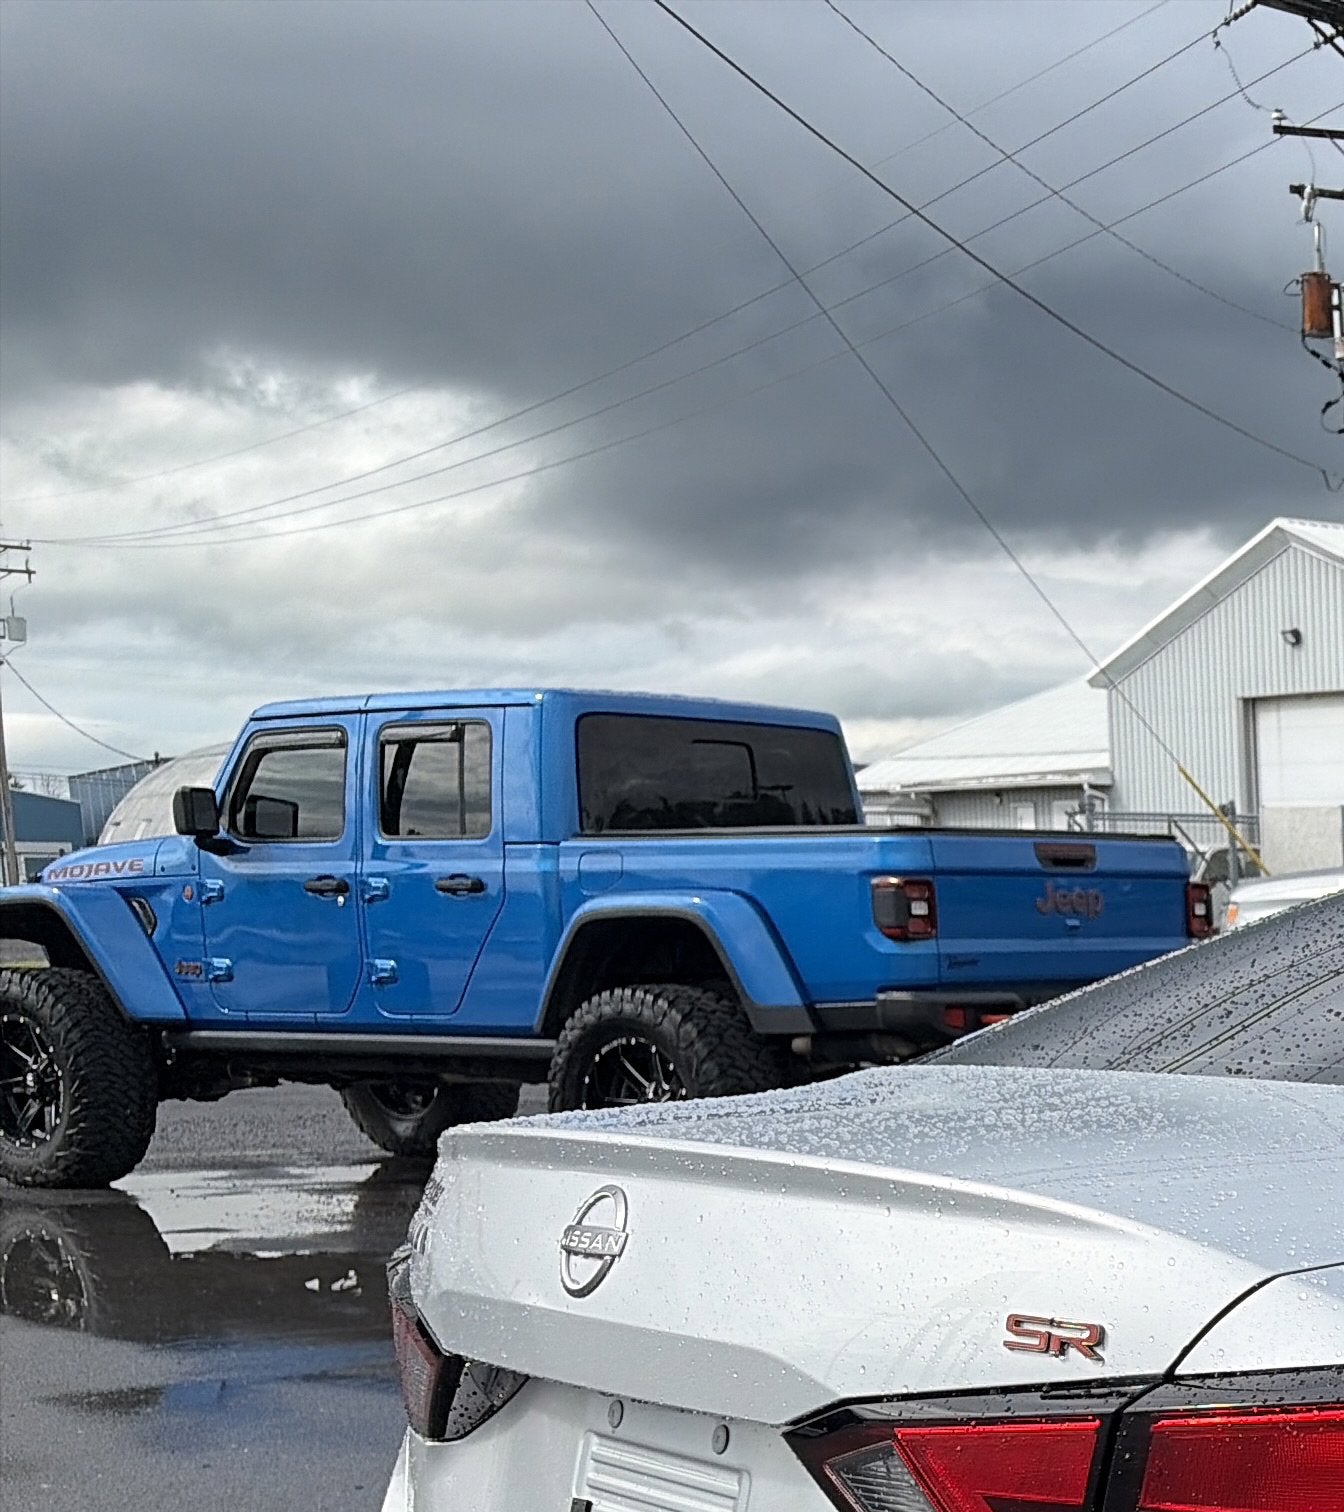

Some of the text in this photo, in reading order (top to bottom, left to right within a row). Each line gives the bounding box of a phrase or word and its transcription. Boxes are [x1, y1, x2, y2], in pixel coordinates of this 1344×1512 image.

[48, 858, 144, 880] MOJAVE
[1036, 881, 1105, 919] Jeep
[1003, 1314, 1105, 1363] SR
